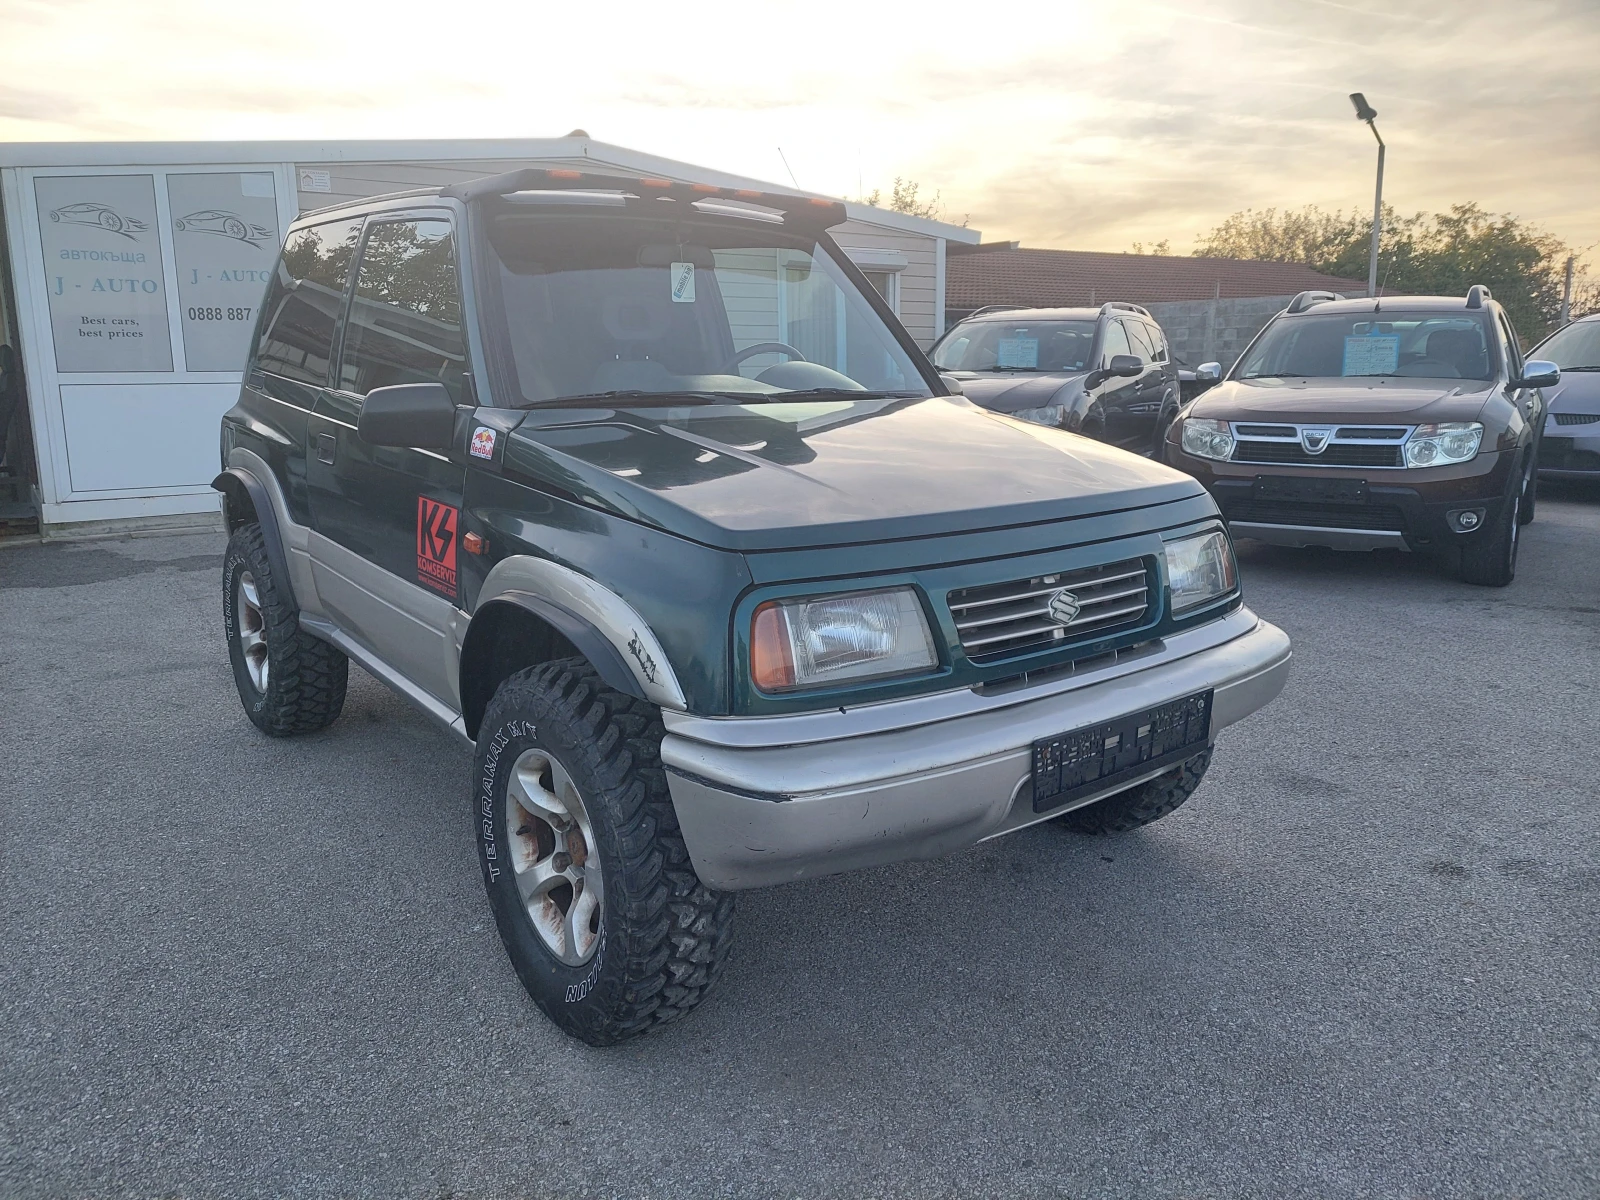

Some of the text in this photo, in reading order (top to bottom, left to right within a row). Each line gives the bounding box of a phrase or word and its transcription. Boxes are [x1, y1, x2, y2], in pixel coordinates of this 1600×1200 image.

[60, 249, 146, 264] автокъща
[191, 268, 199, 284] J
[220, 269, 271, 283] AUTO
[55, 276, 64, 295] J
[91, 277, 158, 293] AUTO
[81, 315, 140, 326] Best cars,
[188, 307, 223, 321] 0888
[227, 307, 252, 321] 887
[78, 328, 144, 339] best prices
[472, 442, 482, 454] Red
[420, 499, 454, 563] KS
[417, 555, 456, 585] KOMSERVIZ
[481, 727, 509, 883] TERRAMAX
